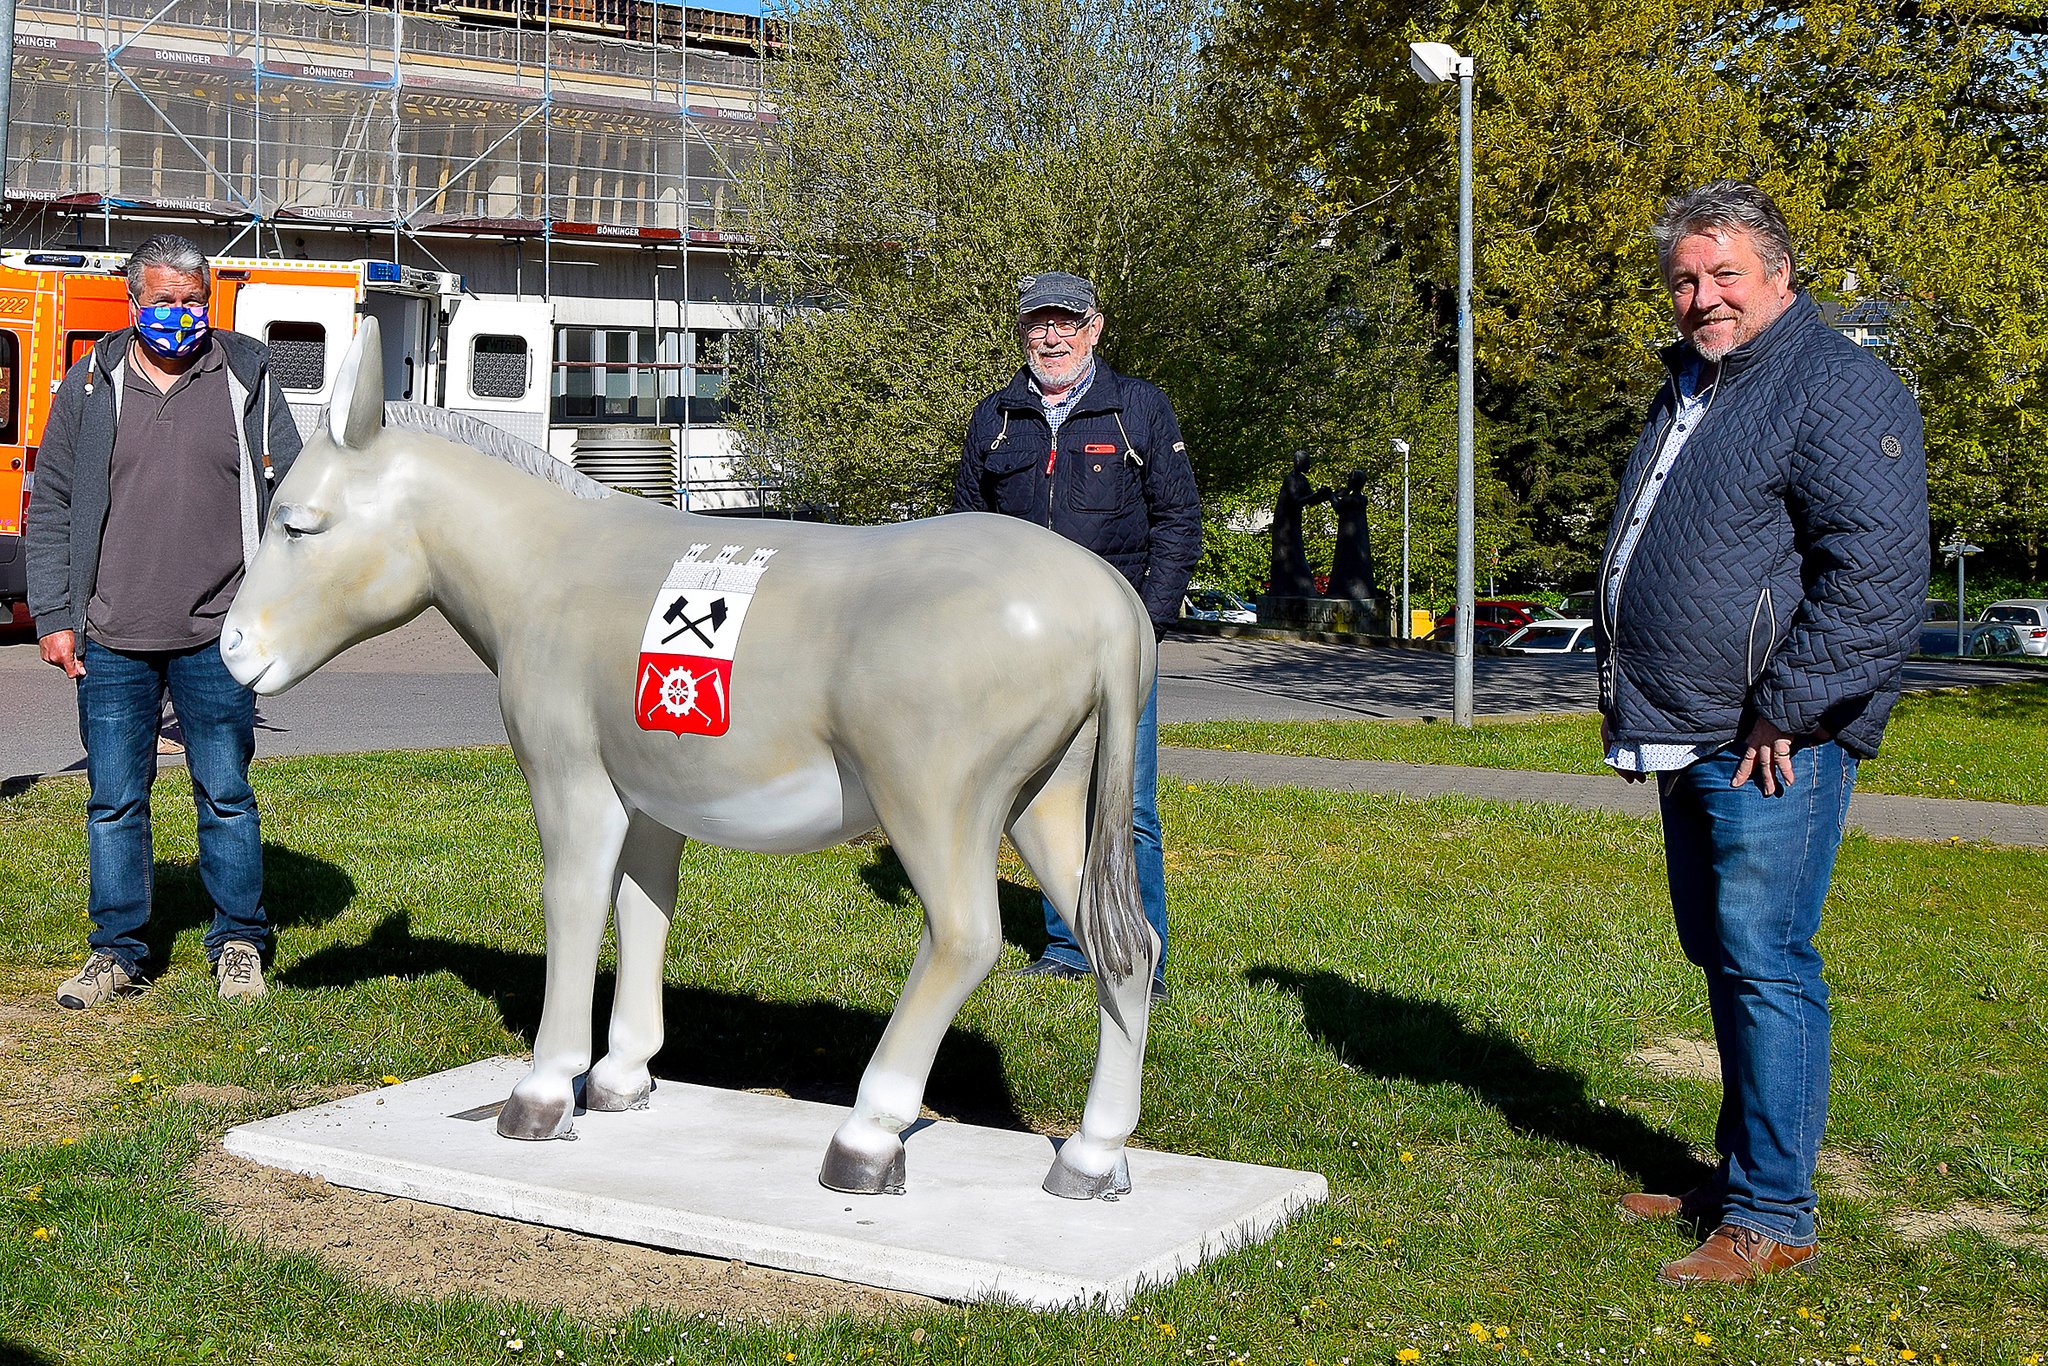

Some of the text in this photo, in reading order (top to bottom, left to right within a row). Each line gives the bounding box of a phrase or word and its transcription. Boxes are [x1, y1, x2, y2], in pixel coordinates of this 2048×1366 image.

[155, 50, 211, 64] BÖNNINGER
[302, 65, 354, 79] BÖNNINGER
[4, 189, 57, 202] ÖNNINGER
[156, 199, 211, 211] BÖNNINGER
[302, 207, 354, 219] BÖNNINGER
[596, 225, 640, 237] BÖNNINGER
